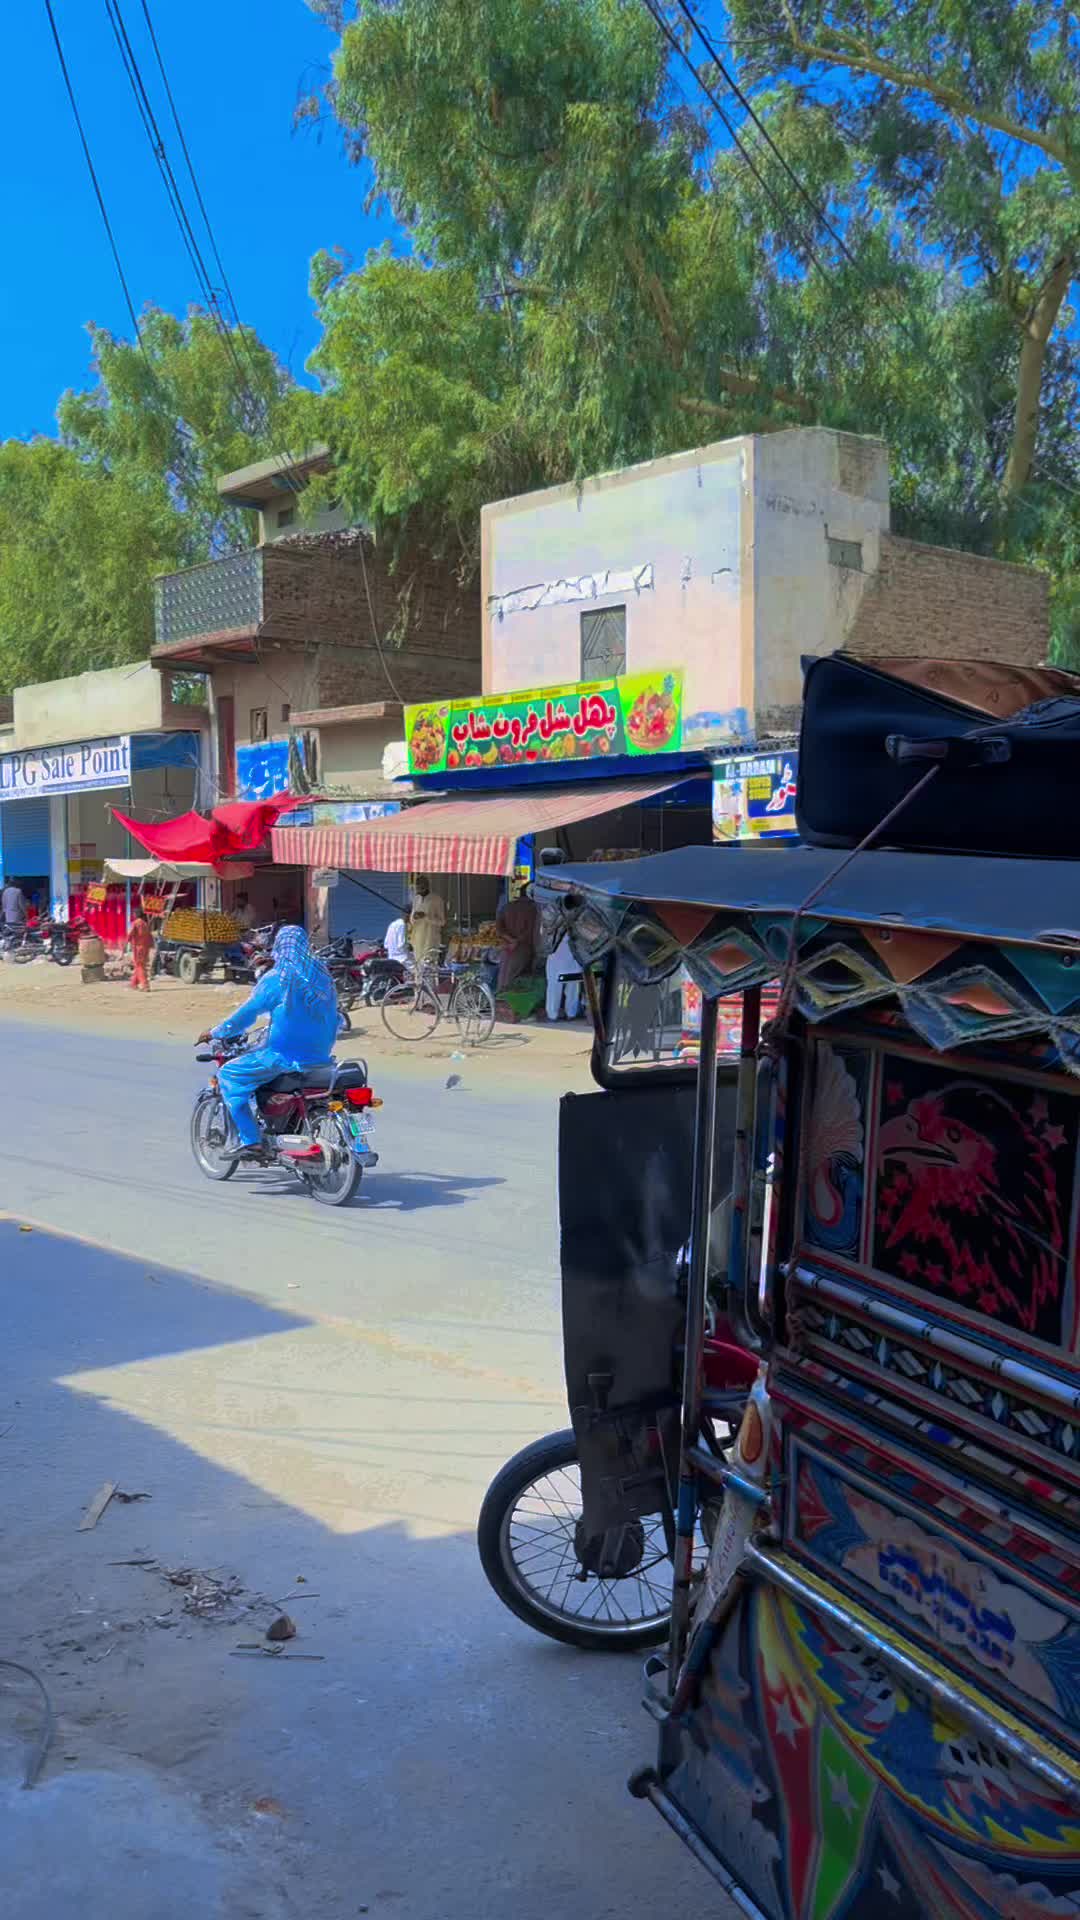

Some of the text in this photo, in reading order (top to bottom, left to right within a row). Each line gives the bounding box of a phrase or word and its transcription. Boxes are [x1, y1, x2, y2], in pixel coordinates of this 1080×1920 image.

[452, 710, 491, 754] شاپ
[0, 741, 128, 789] LPG Sale Point
